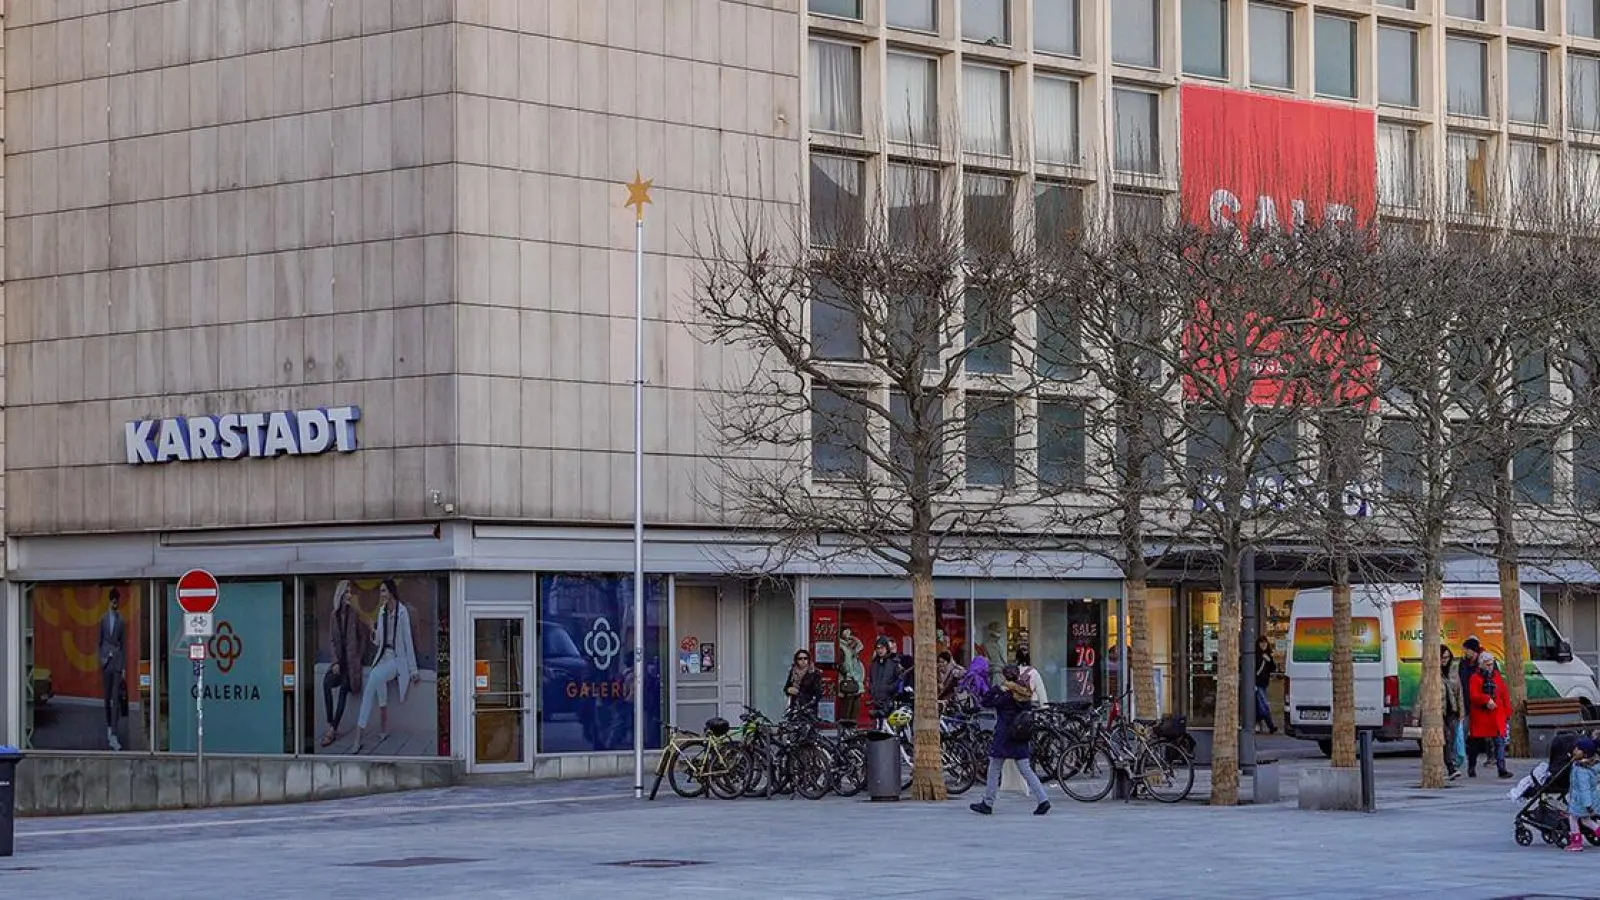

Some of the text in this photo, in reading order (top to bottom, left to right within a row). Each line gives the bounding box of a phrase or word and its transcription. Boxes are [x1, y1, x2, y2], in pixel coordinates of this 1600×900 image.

[125, 405, 359, 462] KARSTADT
[1072, 623, 1097, 637] SALE
[1399, 629, 1445, 641] MUGR
[1075, 645, 1096, 667] 70
